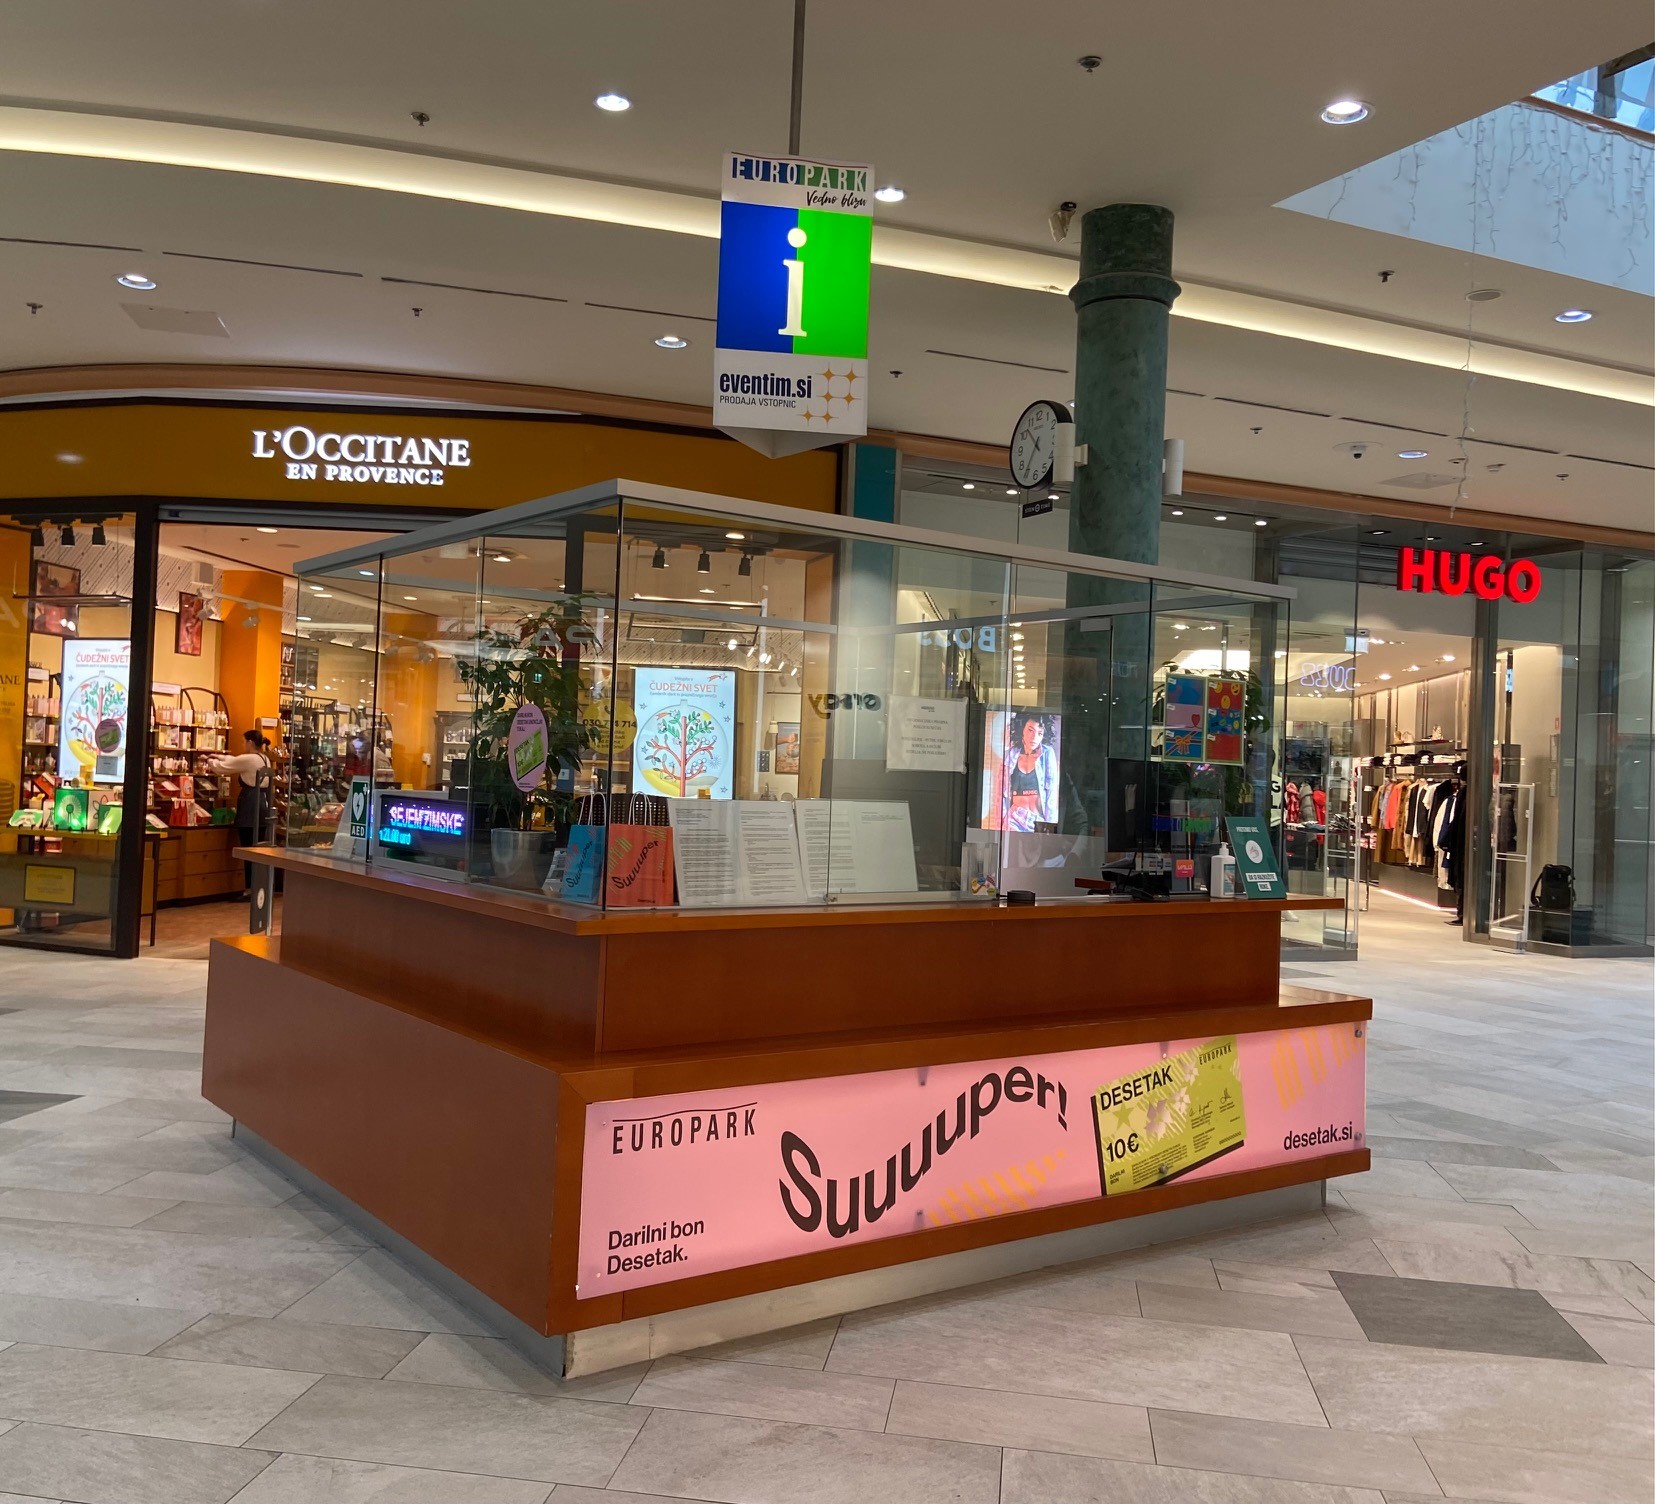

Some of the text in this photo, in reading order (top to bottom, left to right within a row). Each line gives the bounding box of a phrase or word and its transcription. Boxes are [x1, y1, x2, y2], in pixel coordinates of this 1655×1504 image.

[732, 157, 867, 192] EUROPARK
[806, 190, 867, 208] Vedno blizu
[719, 372, 812, 399] eventim.si
[719, 395, 796, 409] PRODAJA VSTOPNIC
[252, 426, 471, 467] L'OCCITANE
[286, 463, 444, 486] EN PROVENCE
[1397, 546, 1542, 604] HUGO
[76, 652, 108, 663] ČUDEŽNI
[649, 680, 718, 693] ČUDEŽNI SVET
[351, 826, 365, 837] AED
[1199, 1044, 1232, 1065] EUROPARK
[1099, 1065, 1173, 1111] DESETAK
[612, 1109, 756, 1154] EUROPARK
[1284, 1121, 1353, 1151] desetak.si
[778, 1065, 1068, 1239] Suuuuper!
[1106, 1133, 1139, 1162] 10€
[608, 1217, 705, 1251] Darilni bon
[606, 1246, 689, 1276] Desetak.
